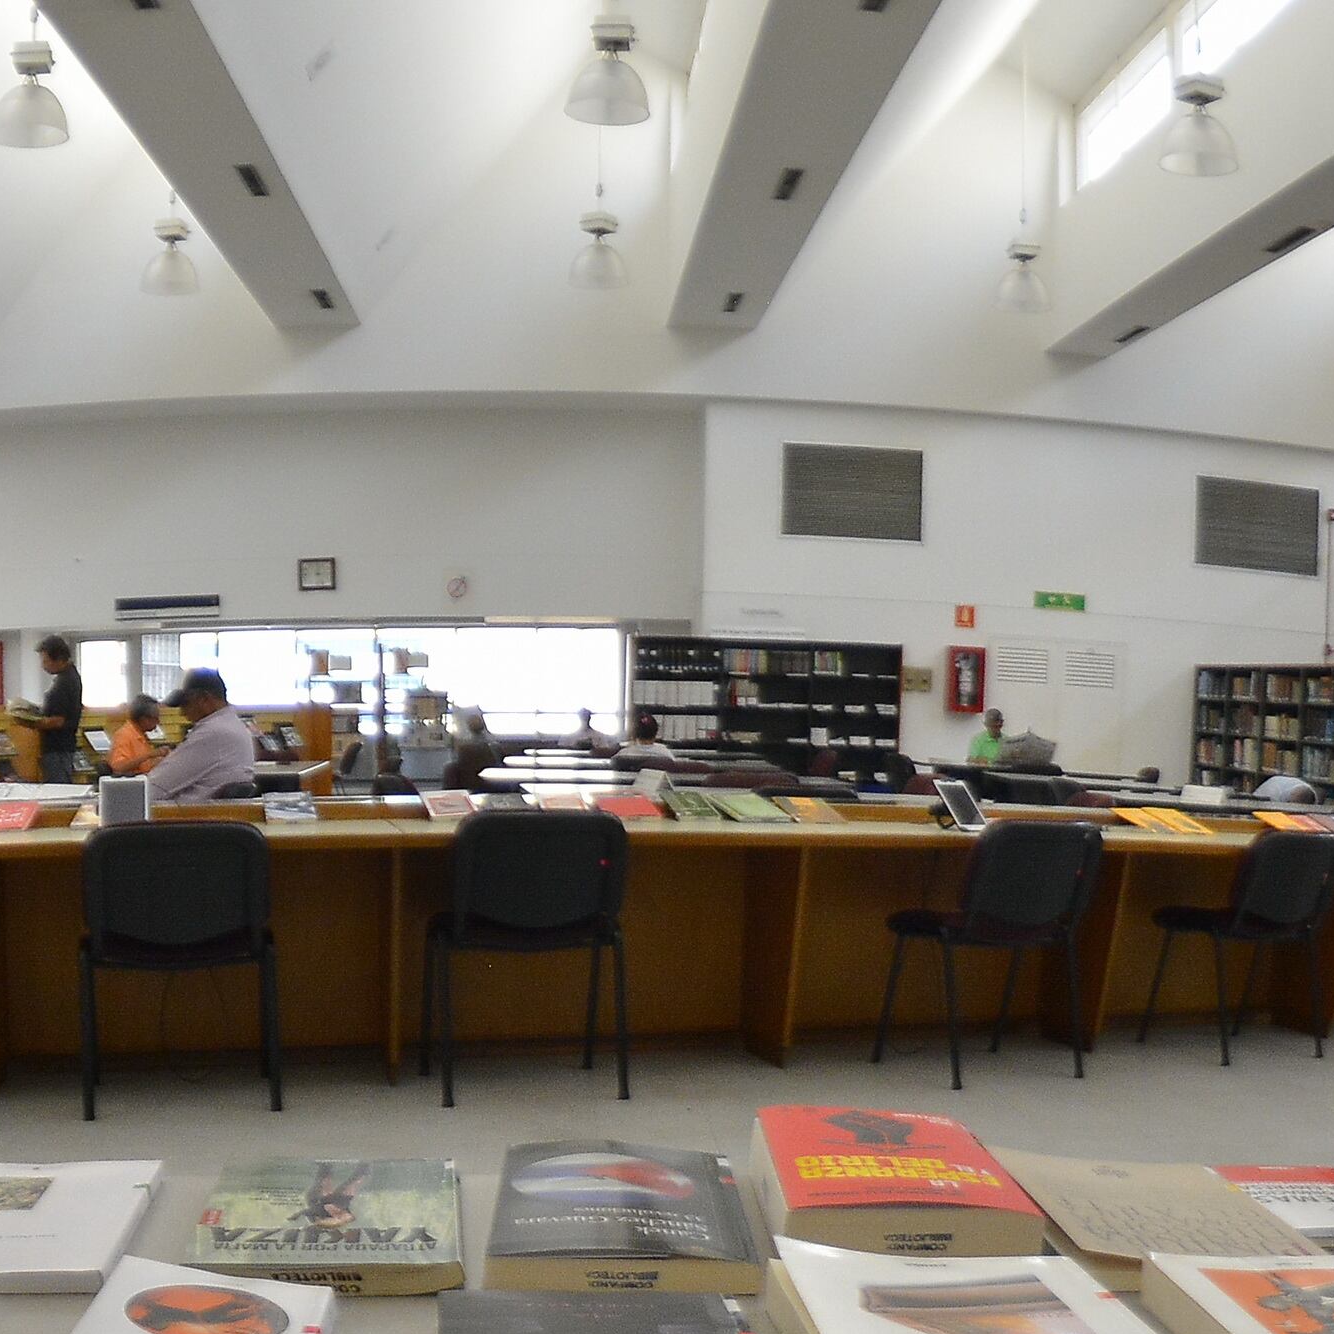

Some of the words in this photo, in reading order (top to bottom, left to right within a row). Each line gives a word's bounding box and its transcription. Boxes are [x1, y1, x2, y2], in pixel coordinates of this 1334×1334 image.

[210, 1226, 437, 1244] YAKUZA
[213, 1242, 266, 1251] MAFIA
[269, 1243, 295, 1251] LA
[299, 1243, 338, 1251] POR
[342, 1241, 437, 1252] ATRAPADA
